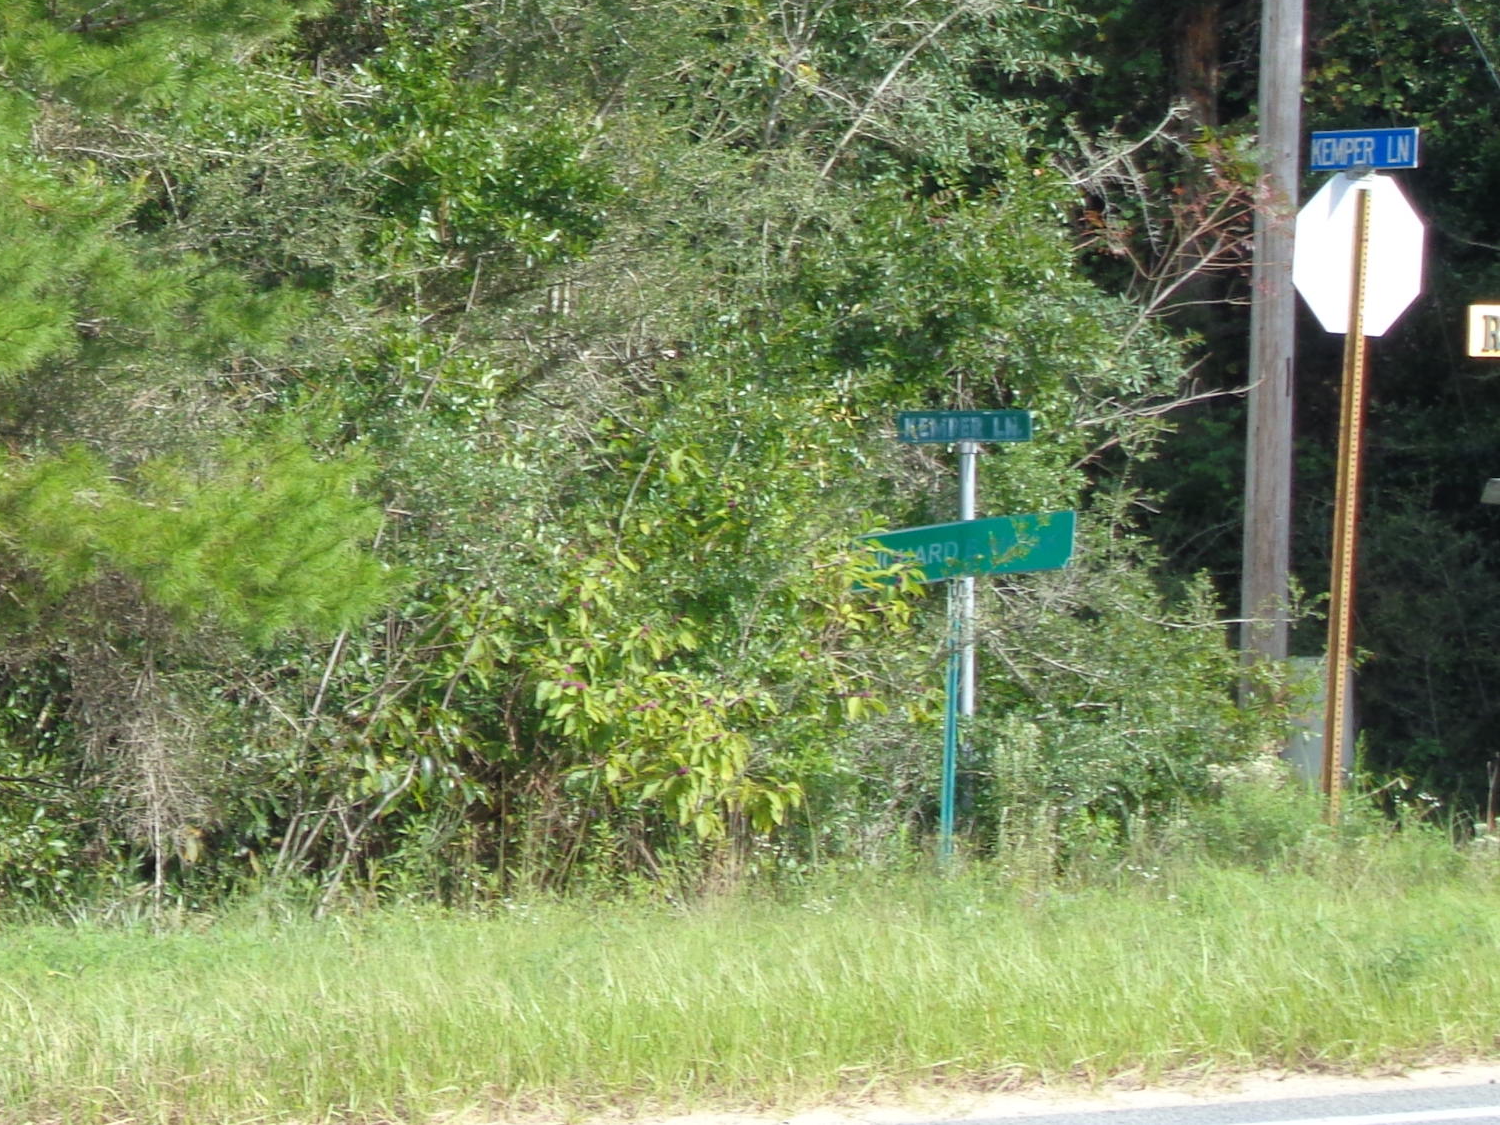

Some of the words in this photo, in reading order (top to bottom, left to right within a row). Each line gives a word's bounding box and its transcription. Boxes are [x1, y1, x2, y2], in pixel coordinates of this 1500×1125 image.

[1311, 137, 1374, 165] KEMPER
[1387, 135, 1409, 163] LN
[904, 417, 982, 437] KEMPER
